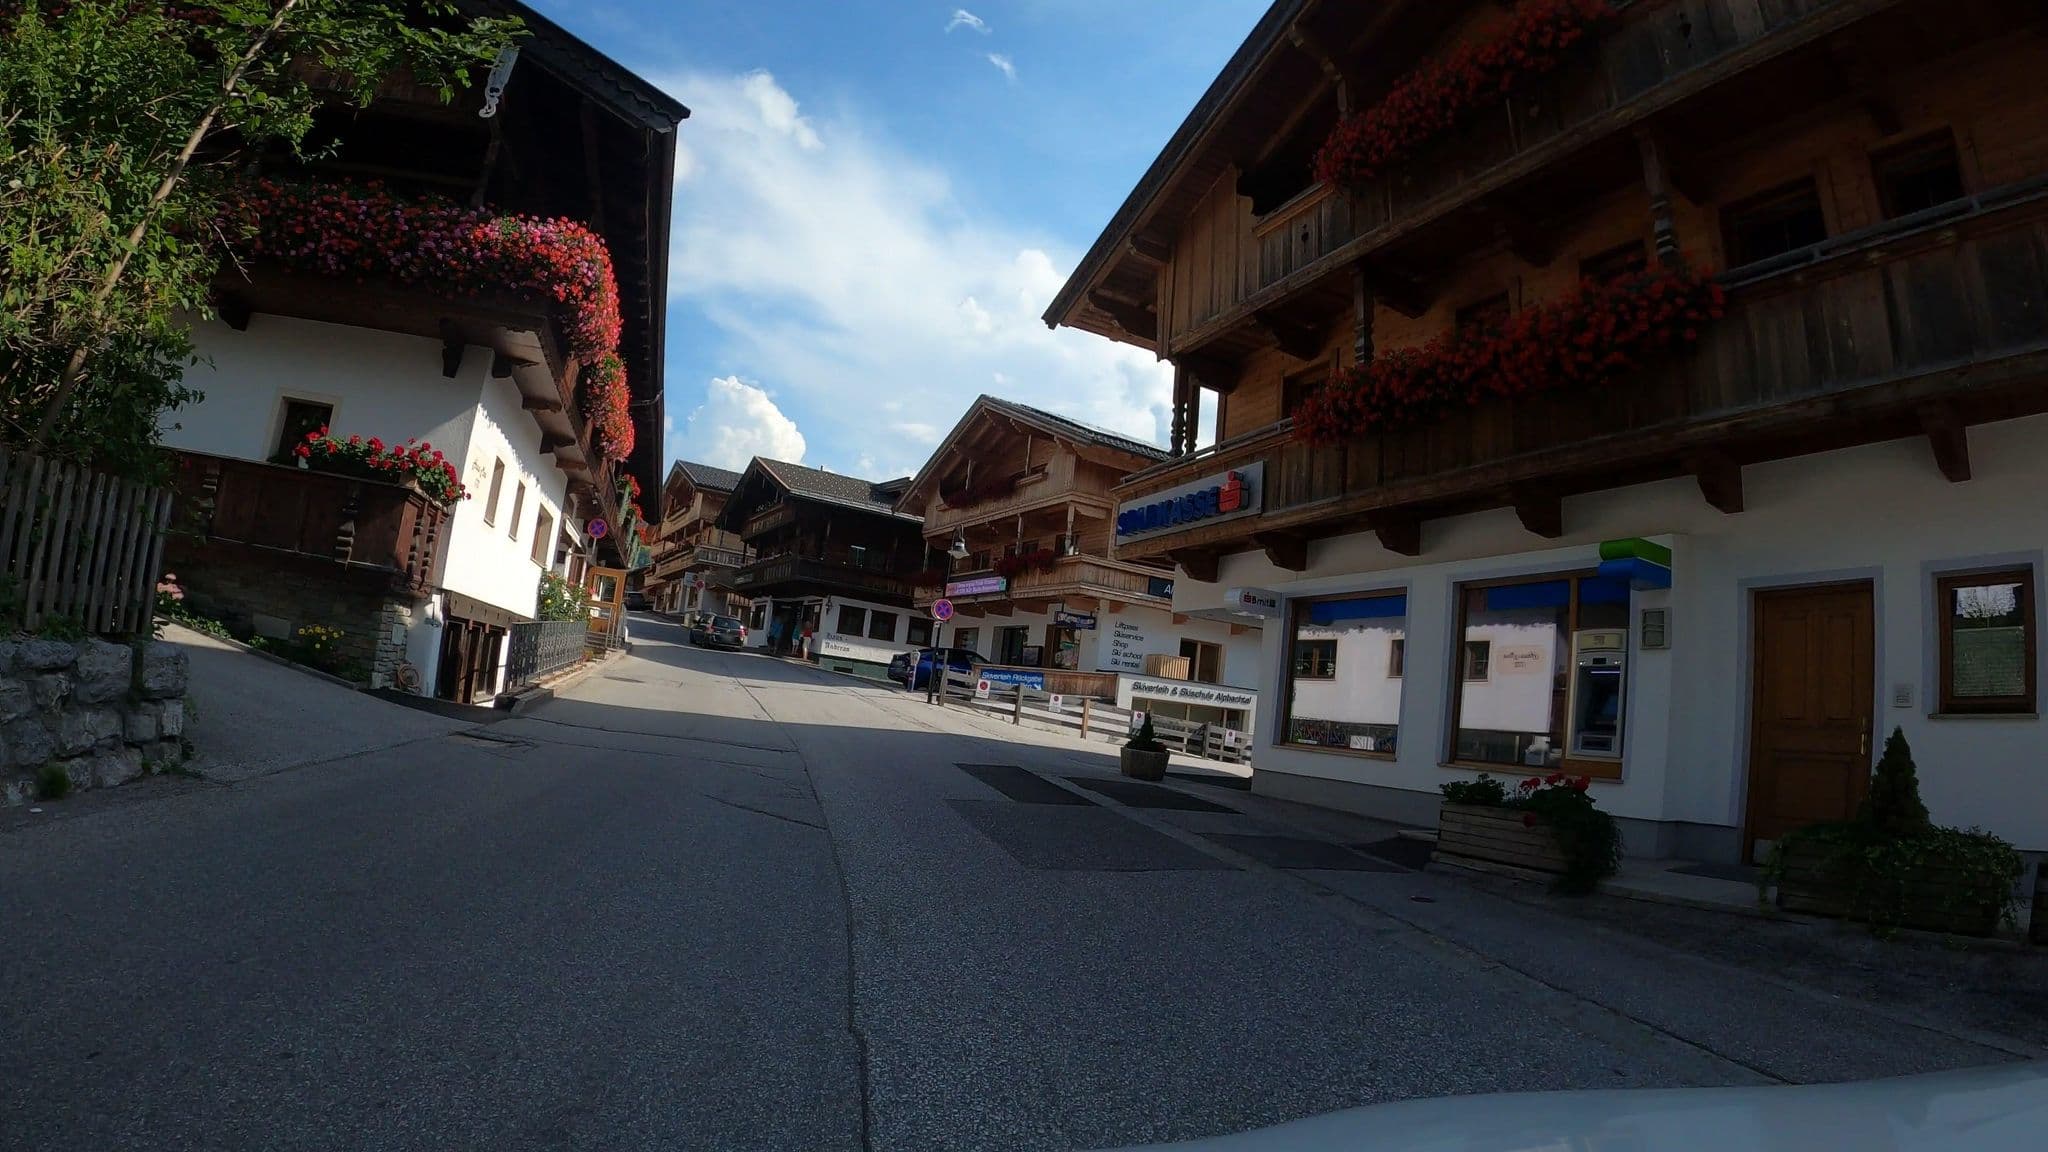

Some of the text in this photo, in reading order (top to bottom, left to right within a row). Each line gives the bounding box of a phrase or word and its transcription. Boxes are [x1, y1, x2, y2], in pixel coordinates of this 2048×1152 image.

[1113, 631, 1144, 642] Skiservice
[1112, 640, 1129, 650] Shop
[1132, 681, 1252, 705] Skiverleih & Skischule Alpbachtal
